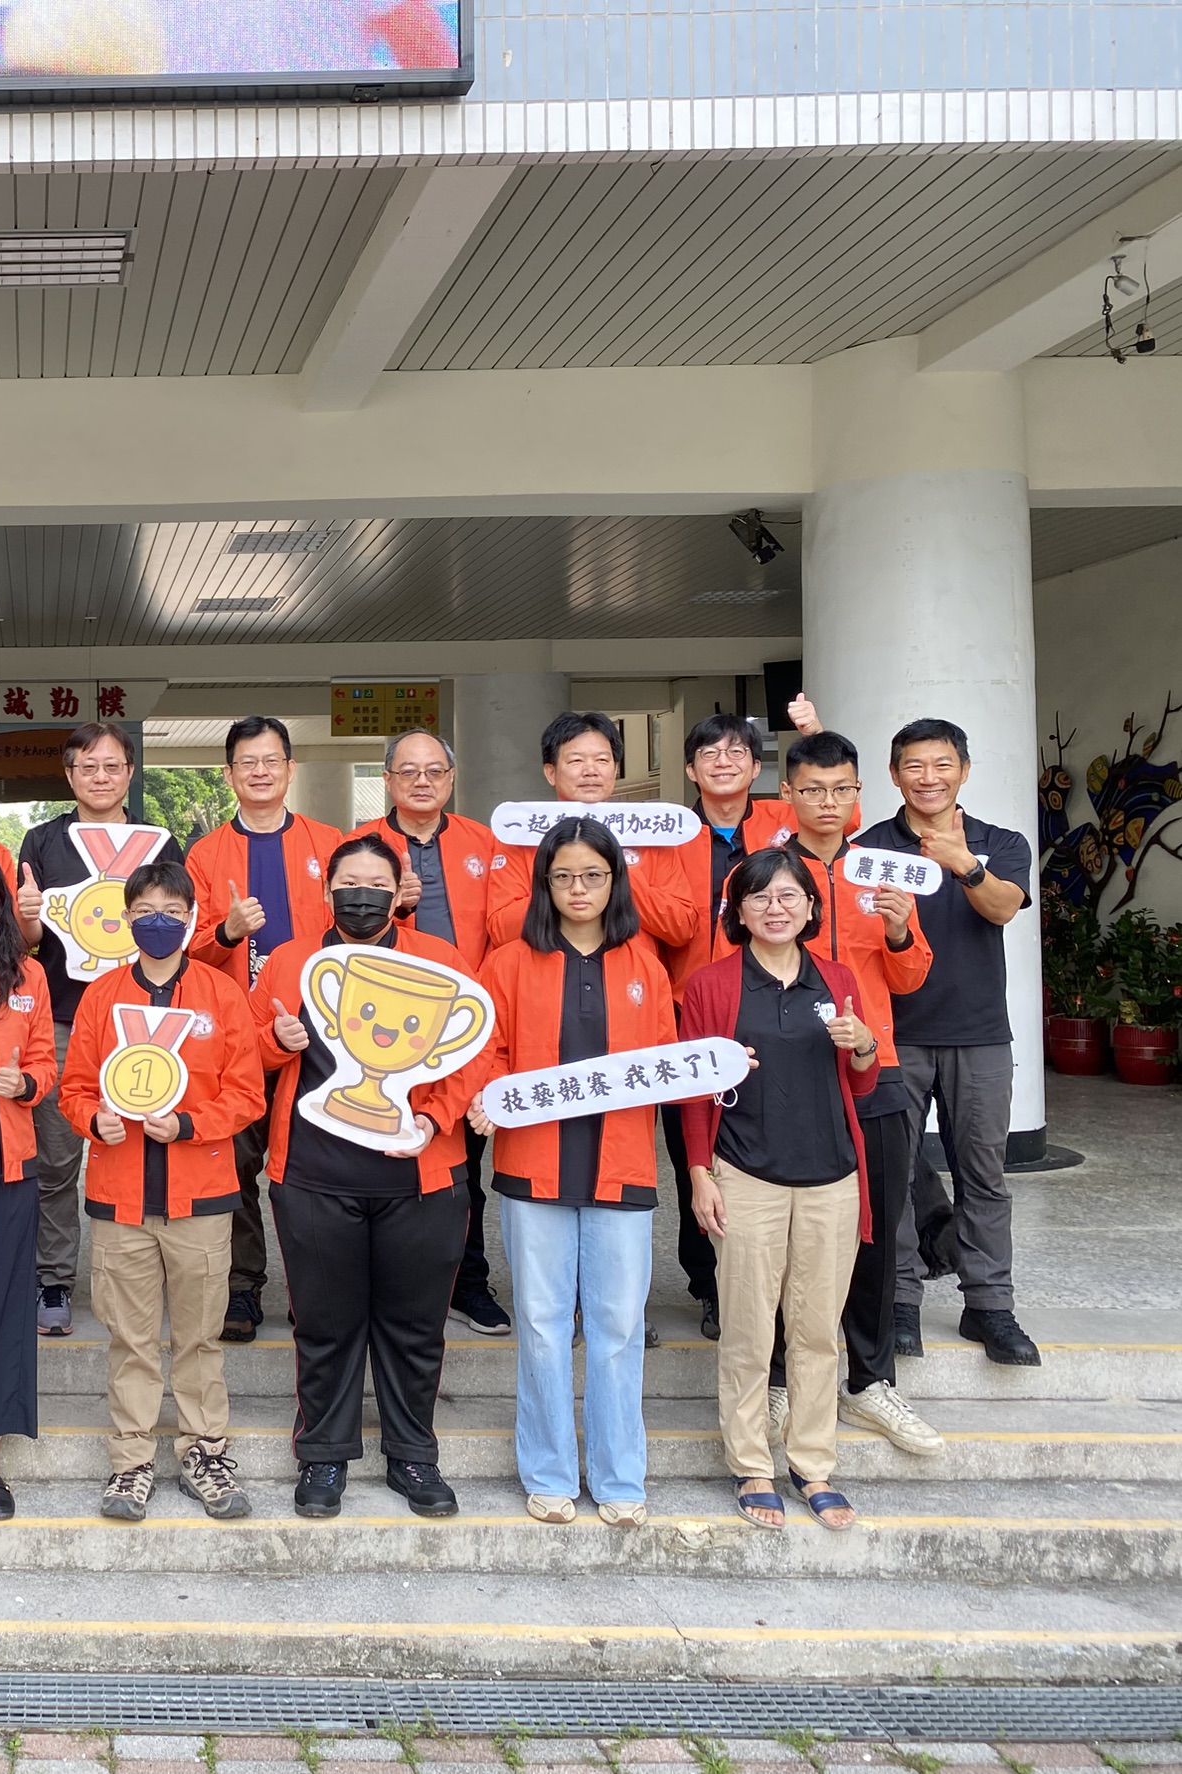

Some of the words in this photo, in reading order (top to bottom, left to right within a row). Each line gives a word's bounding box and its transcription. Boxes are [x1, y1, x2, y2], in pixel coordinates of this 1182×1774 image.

[854, 856, 928, 887] 農業類
[129, 1058, 153, 1098] 1
[500, 1071, 614, 1114] 技藝競賽
[623, 1050, 721, 1091] 我來了!
